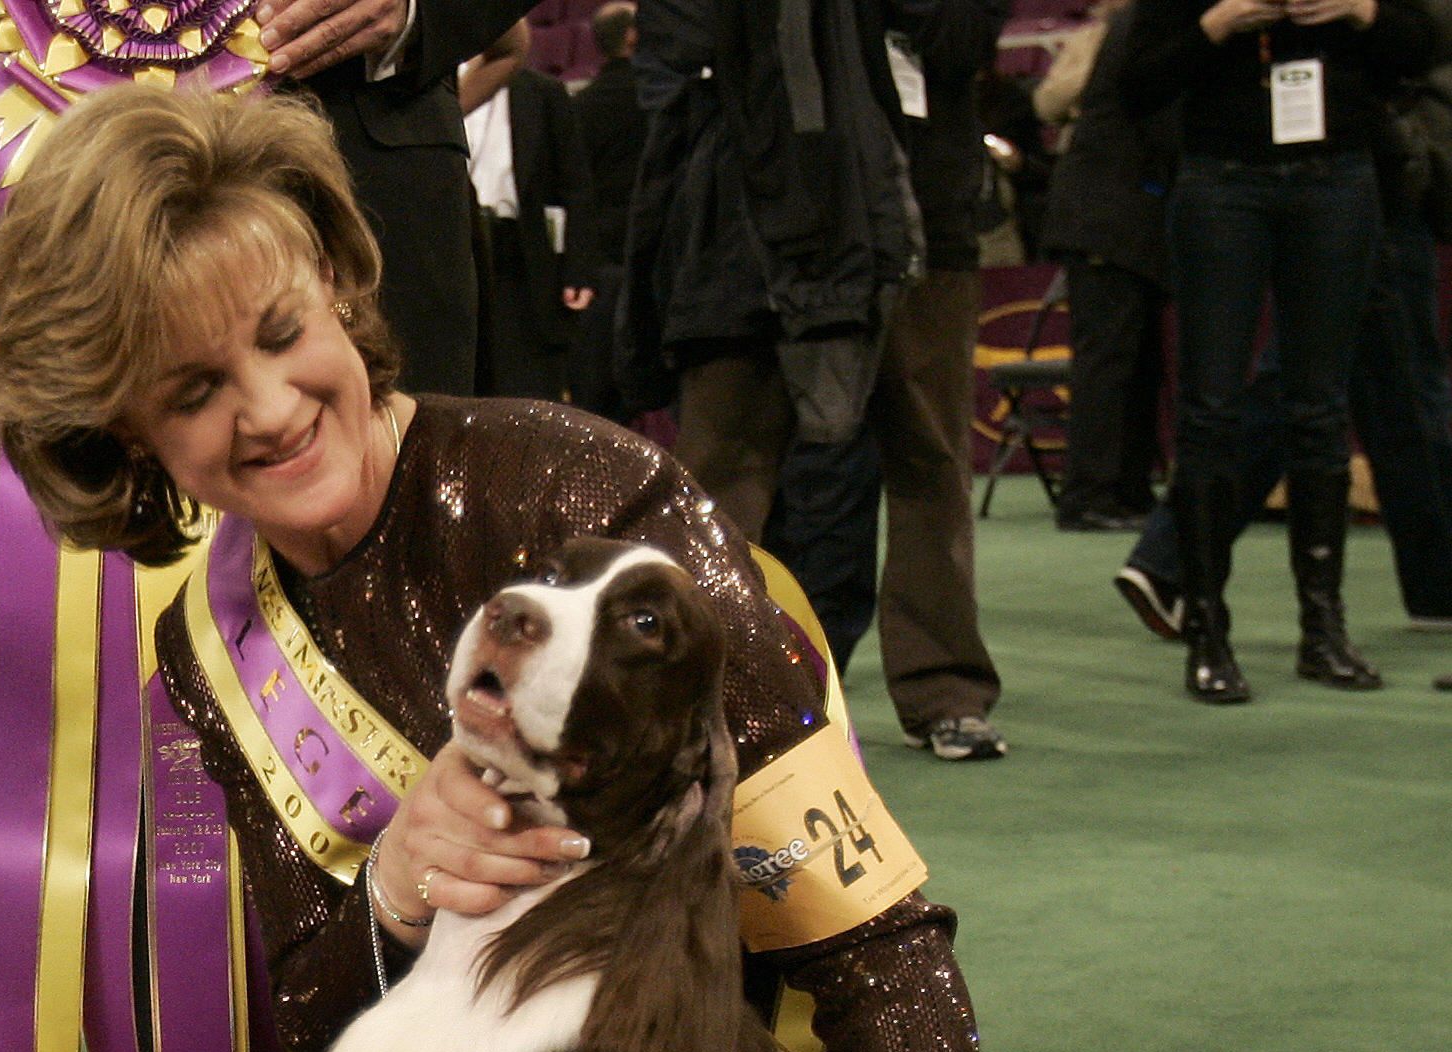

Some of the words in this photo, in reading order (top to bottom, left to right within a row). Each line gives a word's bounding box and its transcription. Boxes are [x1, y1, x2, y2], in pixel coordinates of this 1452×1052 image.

[804, 789, 883, 888] 24
[180, 860, 201, 870] York
[169, 873, 188, 884] New
[191, 873, 211, 884] York
